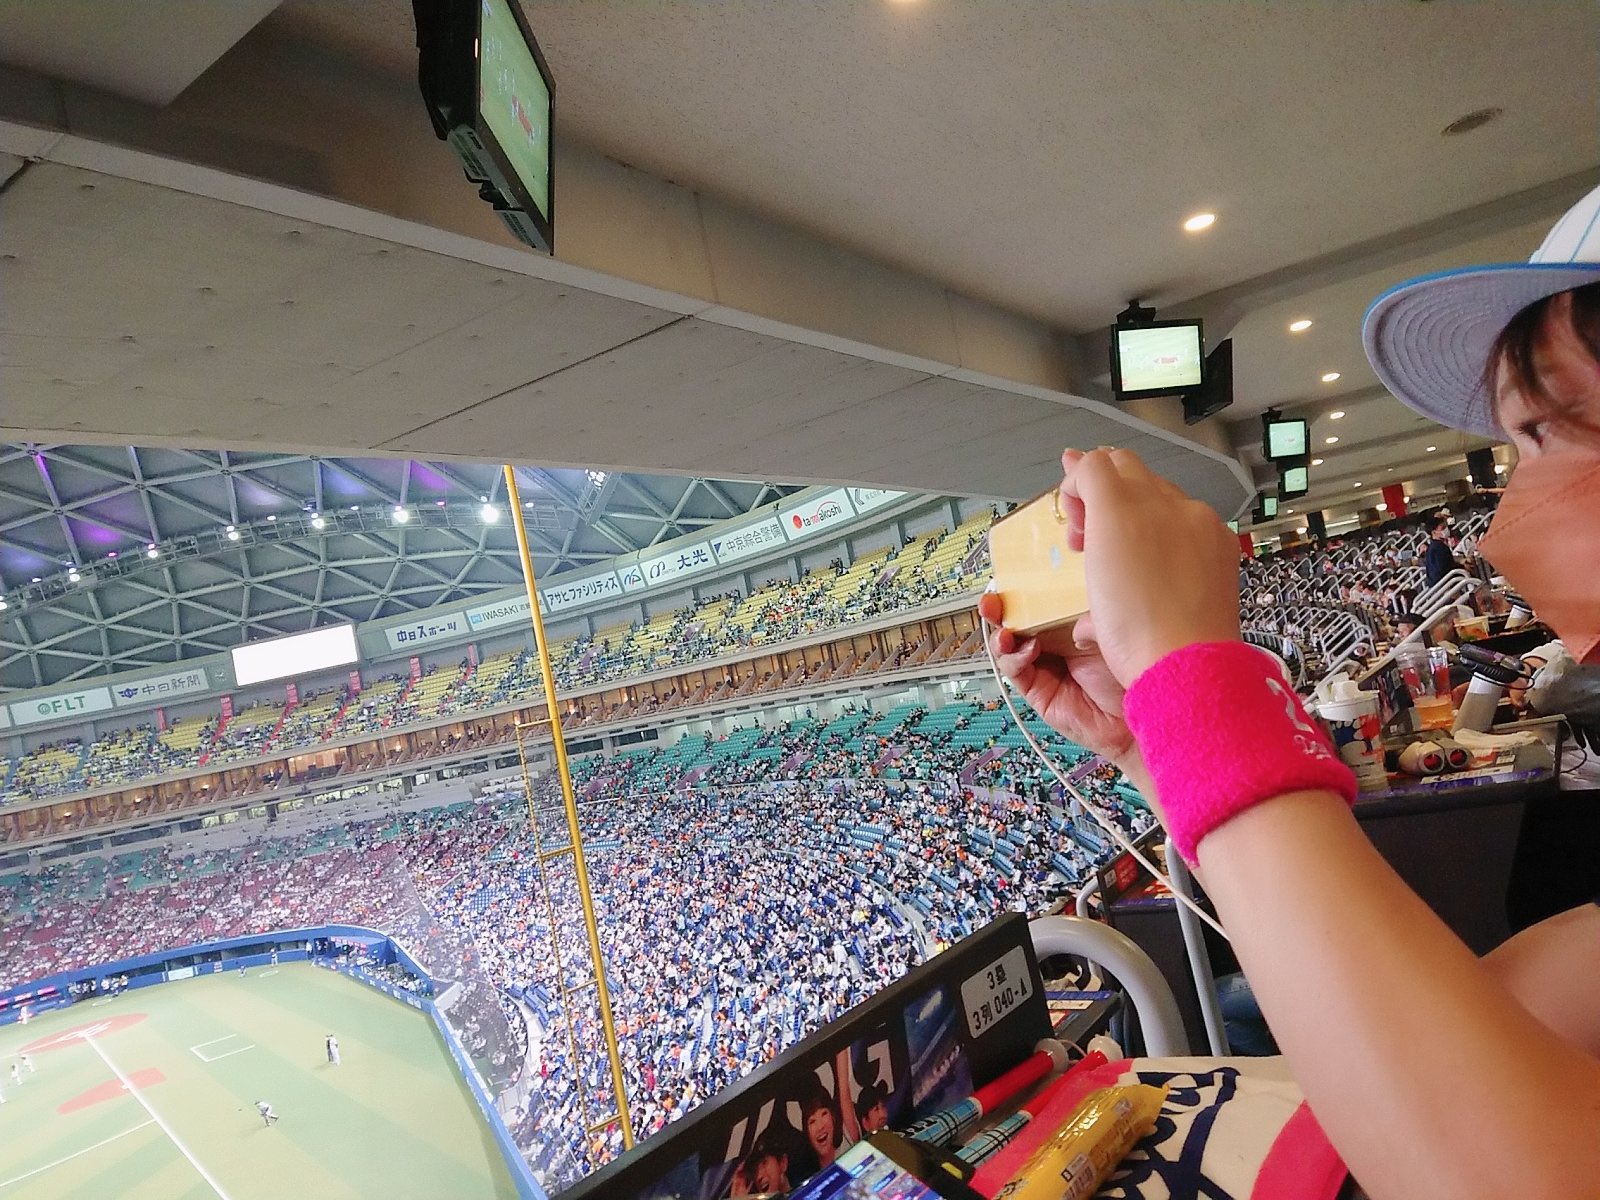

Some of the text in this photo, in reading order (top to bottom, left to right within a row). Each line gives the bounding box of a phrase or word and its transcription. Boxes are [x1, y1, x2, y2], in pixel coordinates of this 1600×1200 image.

[677, 548, 709, 570] 大光
[547, 575, 619, 607] アサヒファシリティズ
[482, 605, 520, 622] IWASAKI
[396, 620, 458, 643] 中日スポーツ
[141, 673, 201, 697] 中日新聞
